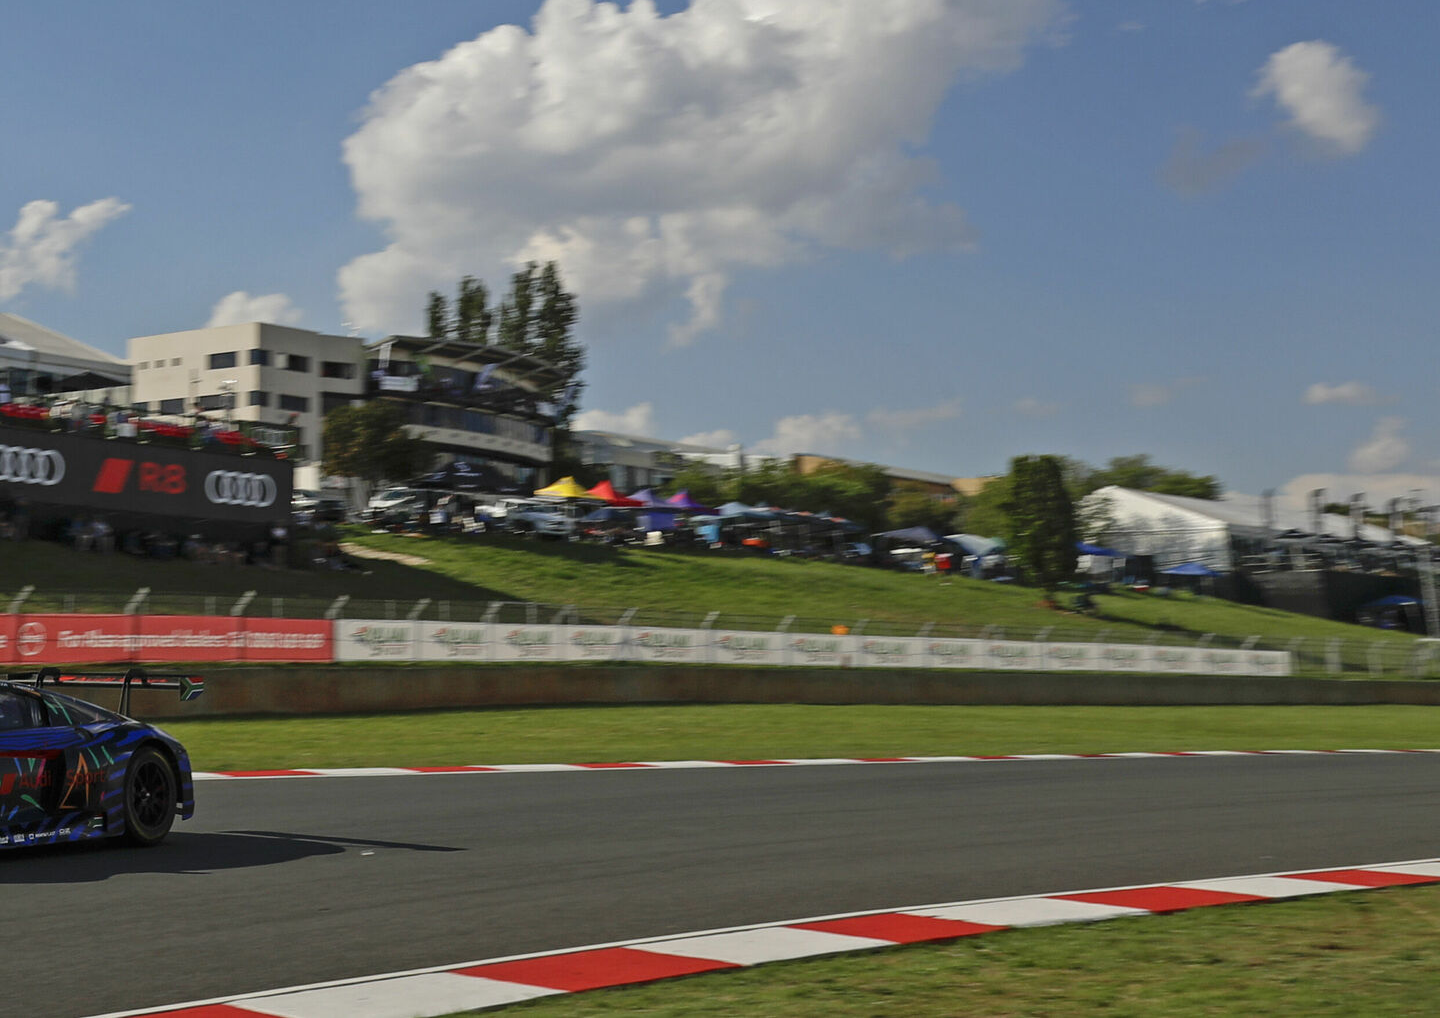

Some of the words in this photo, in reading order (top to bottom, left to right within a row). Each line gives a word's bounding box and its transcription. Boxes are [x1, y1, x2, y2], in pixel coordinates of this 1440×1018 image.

[139, 462, 186, 494] R8
[19, 770, 53, 789] Audi
[66, 769, 106, 789] Sport
